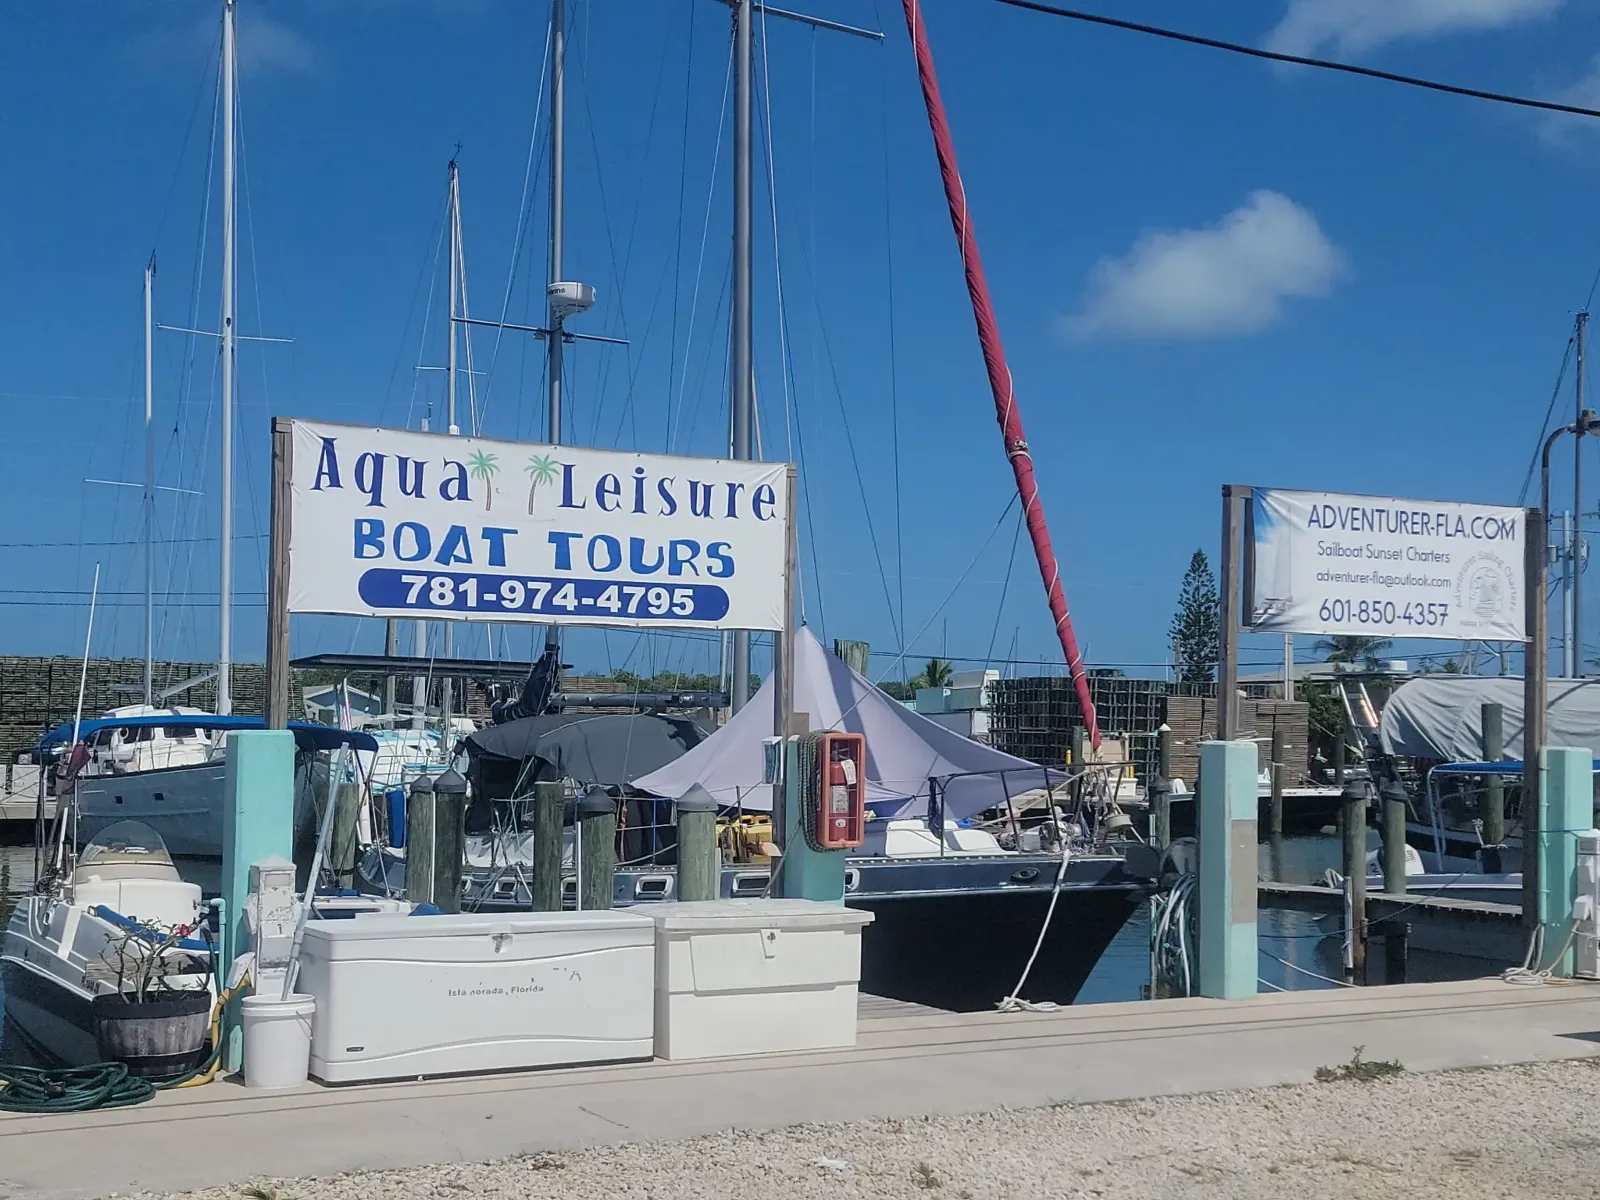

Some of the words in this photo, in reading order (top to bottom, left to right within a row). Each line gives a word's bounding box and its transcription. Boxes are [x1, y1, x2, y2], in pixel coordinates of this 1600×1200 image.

[309, 436, 473, 508] Aqua
[557, 462, 777, 522] Leisure
[1307, 504, 1516, 541] ADVENTURER-FLA.COM
[353, 518, 518, 567] BOAT
[548, 530, 736, 578] TOURS
[1317, 540, 1363, 559] Sailboat
[1366, 543, 1403, 562] Sunset
[1406, 546, 1451, 564] Charters
[401, 574, 695, 616] 781-974-4795
[1316, 569, 1452, 589] adventurer-fla@outlook.com
[1318, 597, 1449, 627] 601-850-4357
[510, 985, 544, 994] Florida
